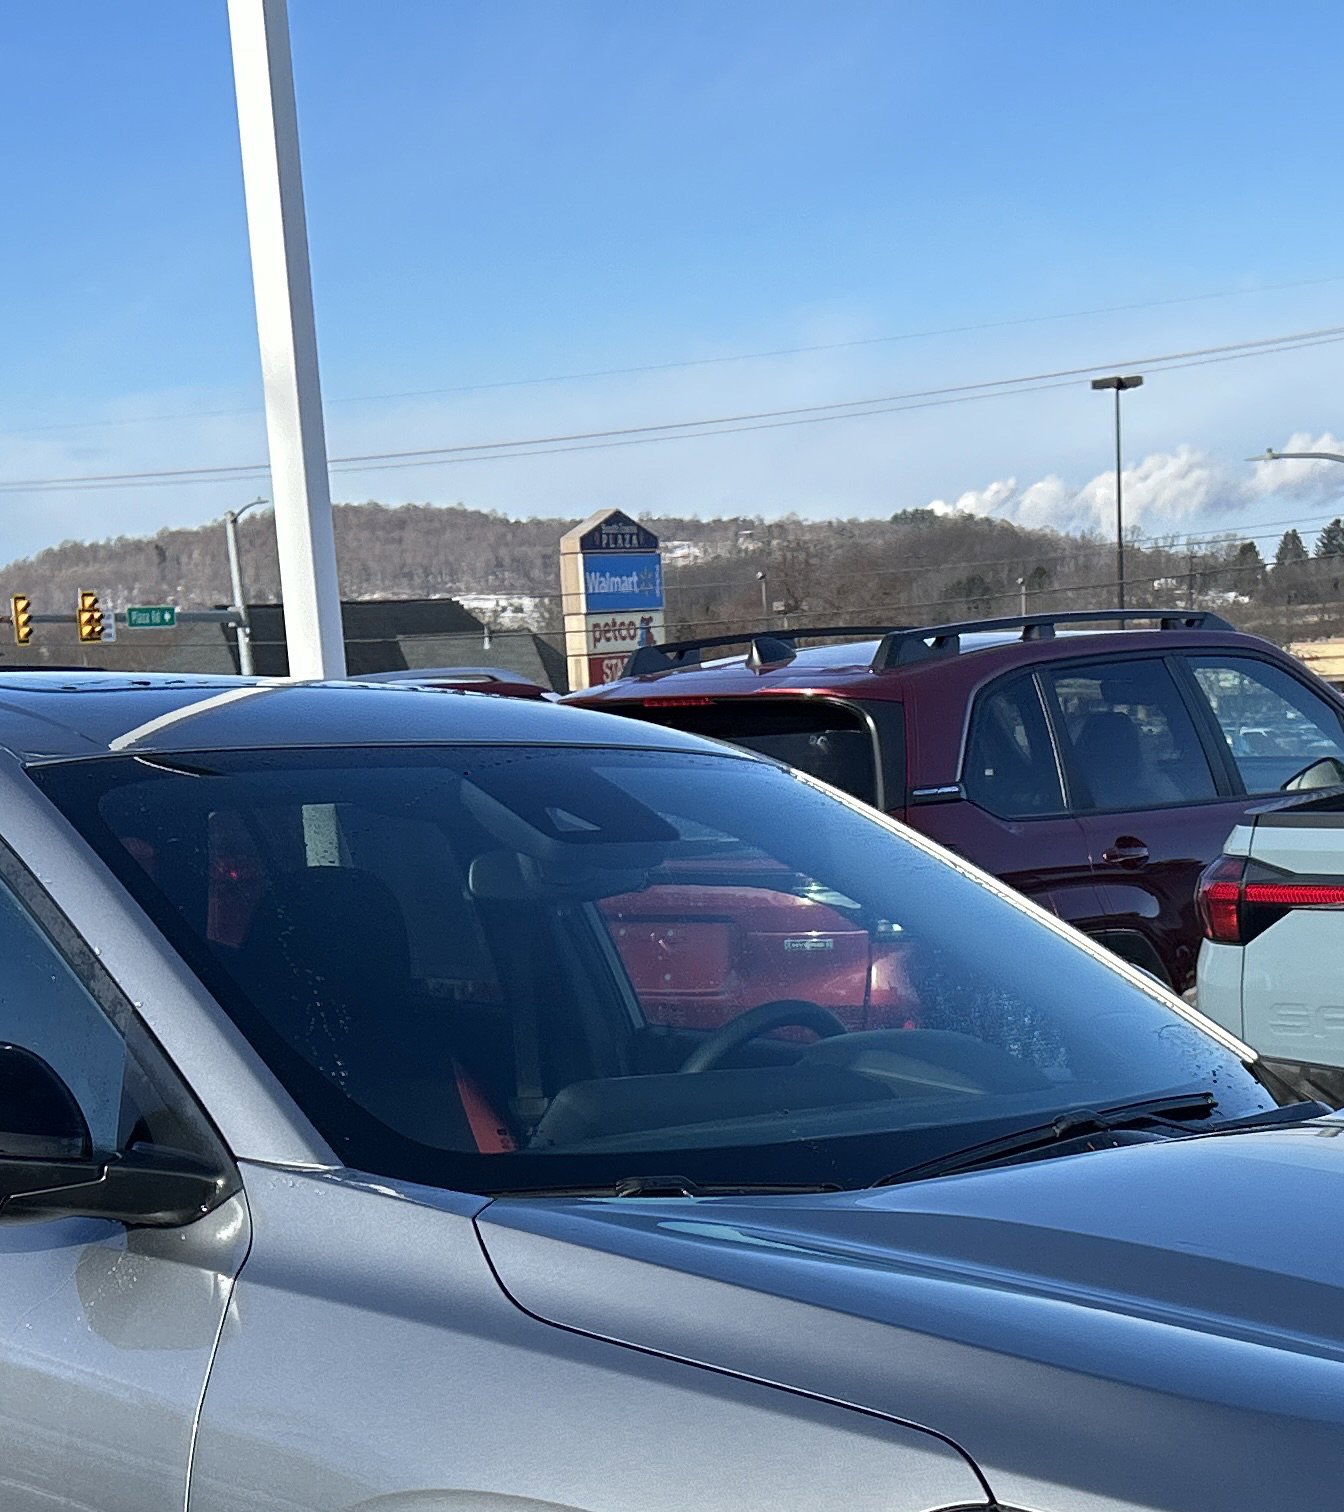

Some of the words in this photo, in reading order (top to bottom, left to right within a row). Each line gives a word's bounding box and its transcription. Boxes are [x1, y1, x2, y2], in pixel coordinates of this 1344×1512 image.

[601, 534, 639, 548] PLAZA
[586, 571, 639, 593] Walmart
[592, 618, 637, 649] petco
